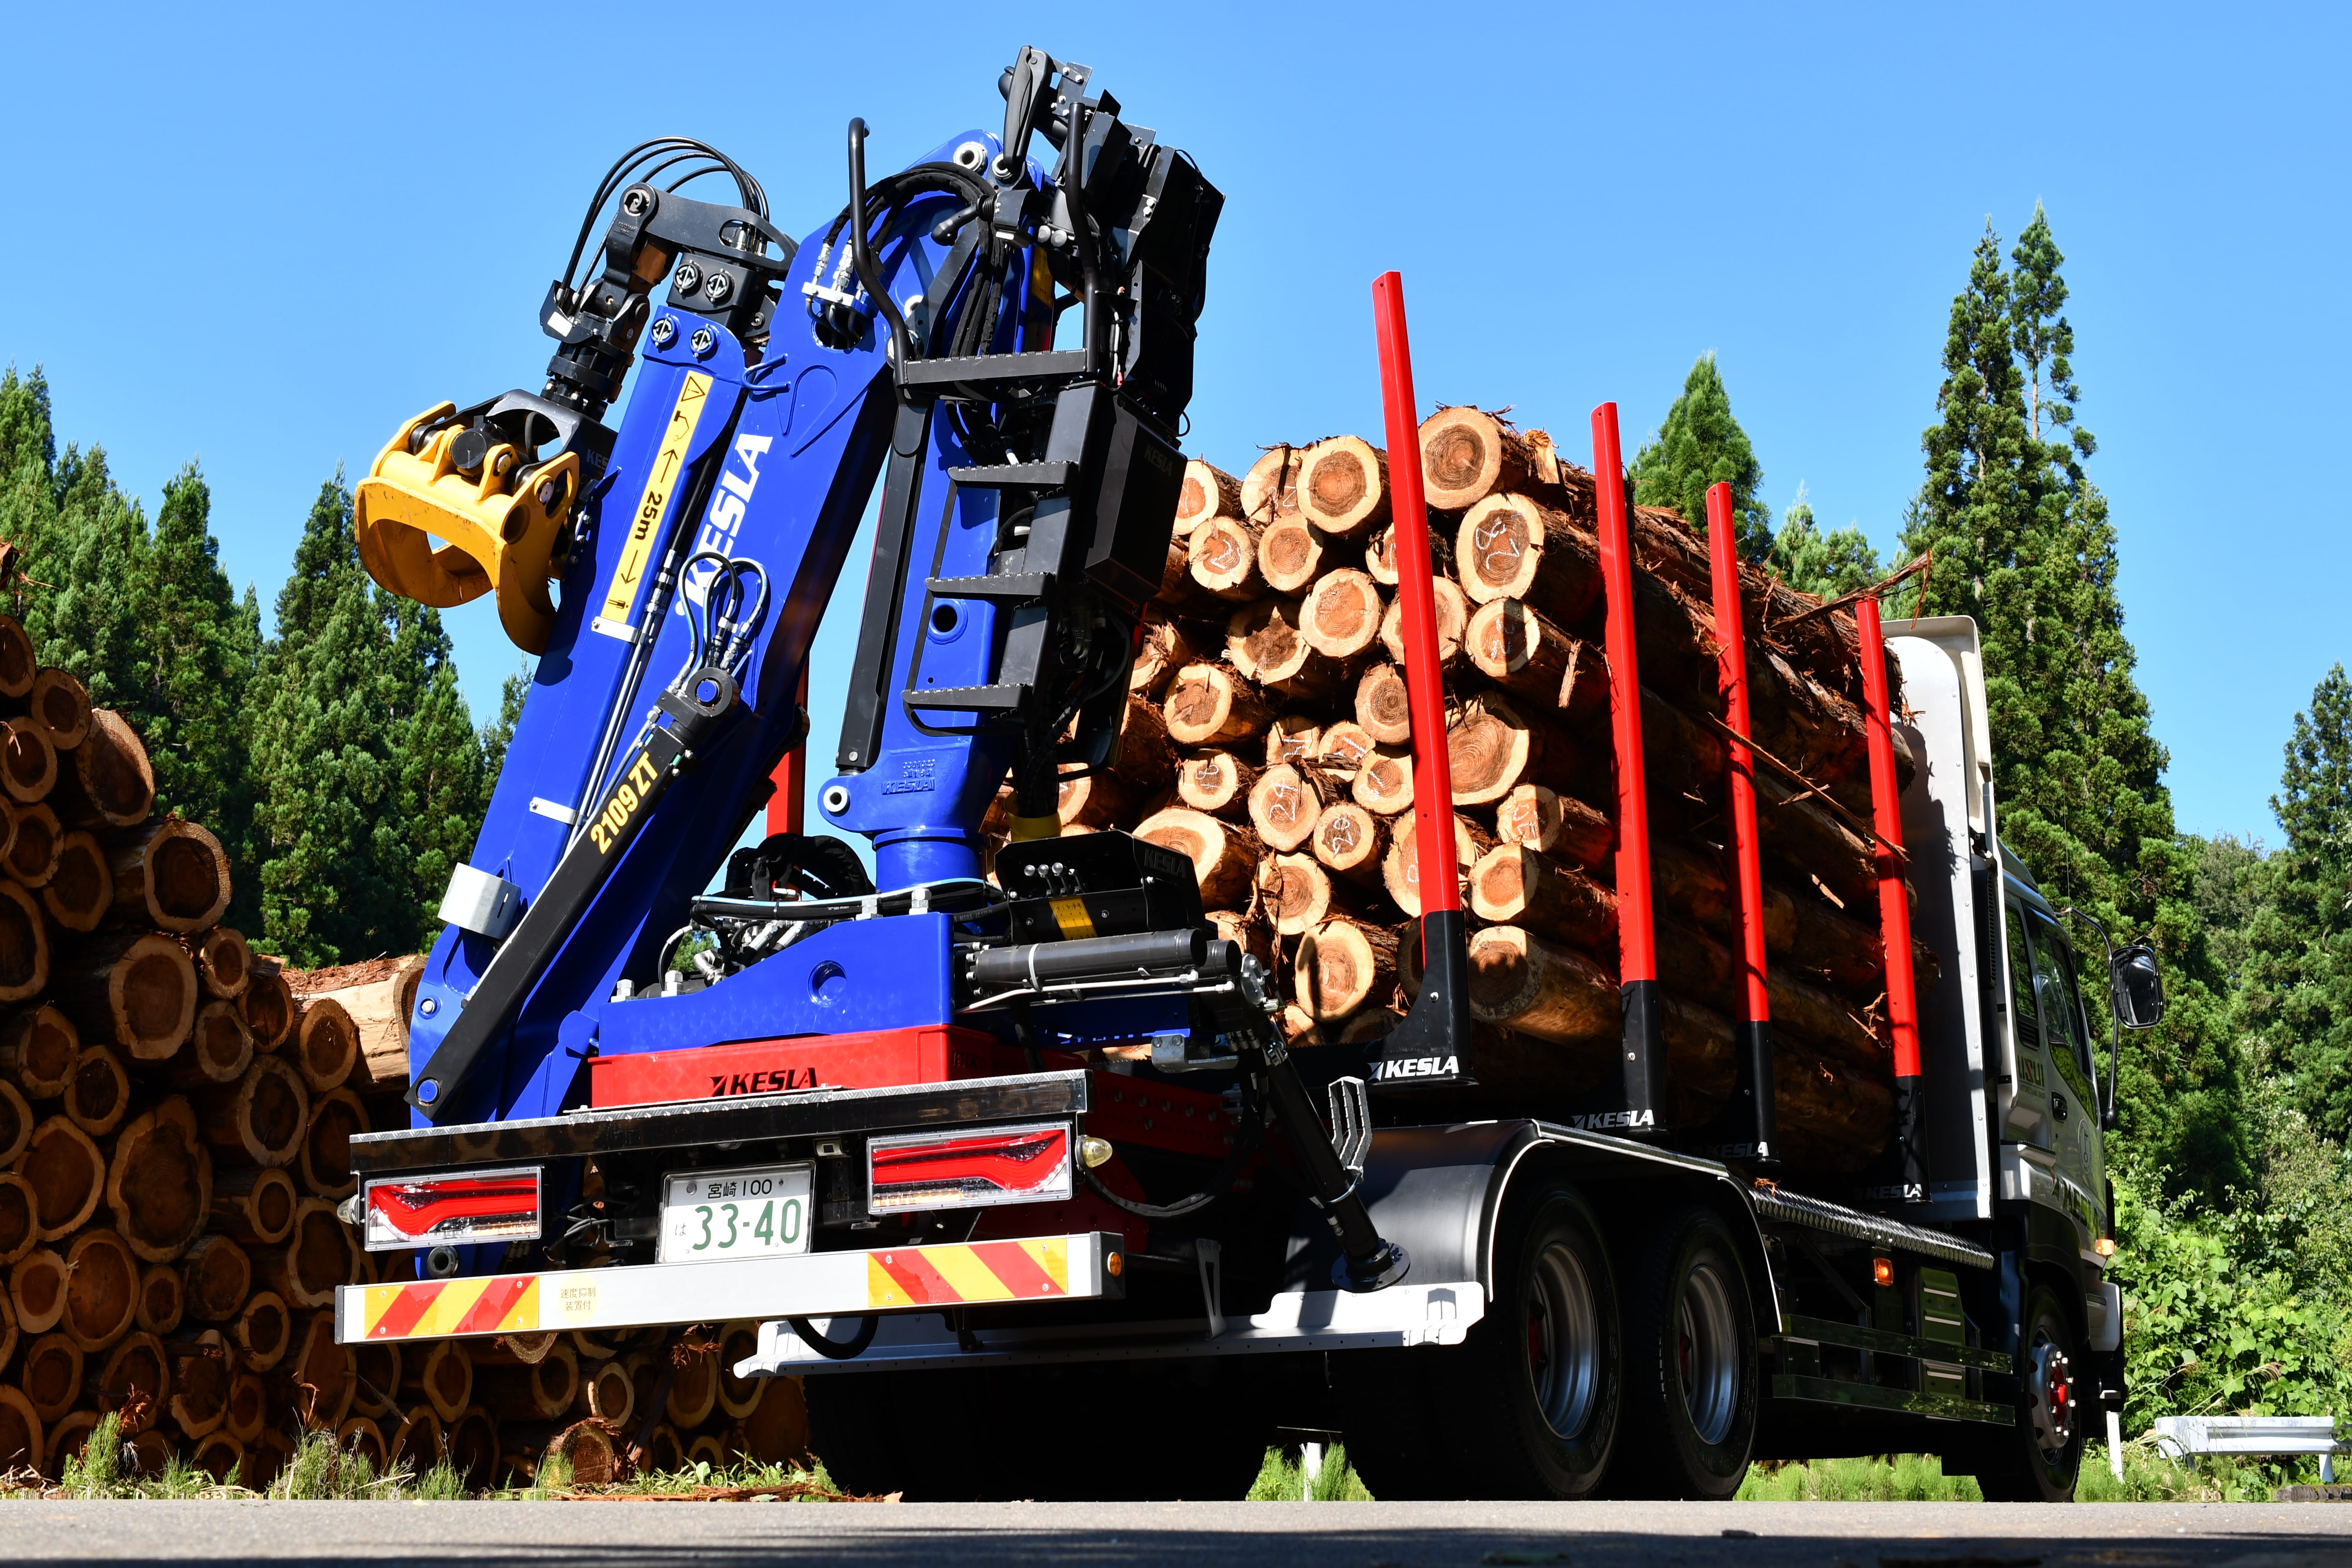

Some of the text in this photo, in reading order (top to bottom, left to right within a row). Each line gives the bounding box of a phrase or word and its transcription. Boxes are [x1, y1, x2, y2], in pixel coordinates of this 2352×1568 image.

[1144, 444, 1173, 476] KESLA
[634, 490, 663, 540] 25m
[684, 433, 773, 607] KESLA
[885, 778, 935, 795] KESLA
[1144, 848, 1187, 879] KESLA
[1385, 1056, 1459, 1078] KESLA
[730, 1067, 818, 1095] KESLA
[1587, 1109, 1654, 1130] KESLA
[1712, 1141, 1769, 1158] KESLA
[708, 1179, 773, 1199] 宮崎 100
[1867, 1184, 1922, 1200] KESLA
[675, 1198, 802, 1250] は 33-40
[561, 1287, 596, 1298] 速度抑制
[565, 1299, 591, 1311] 装置付
